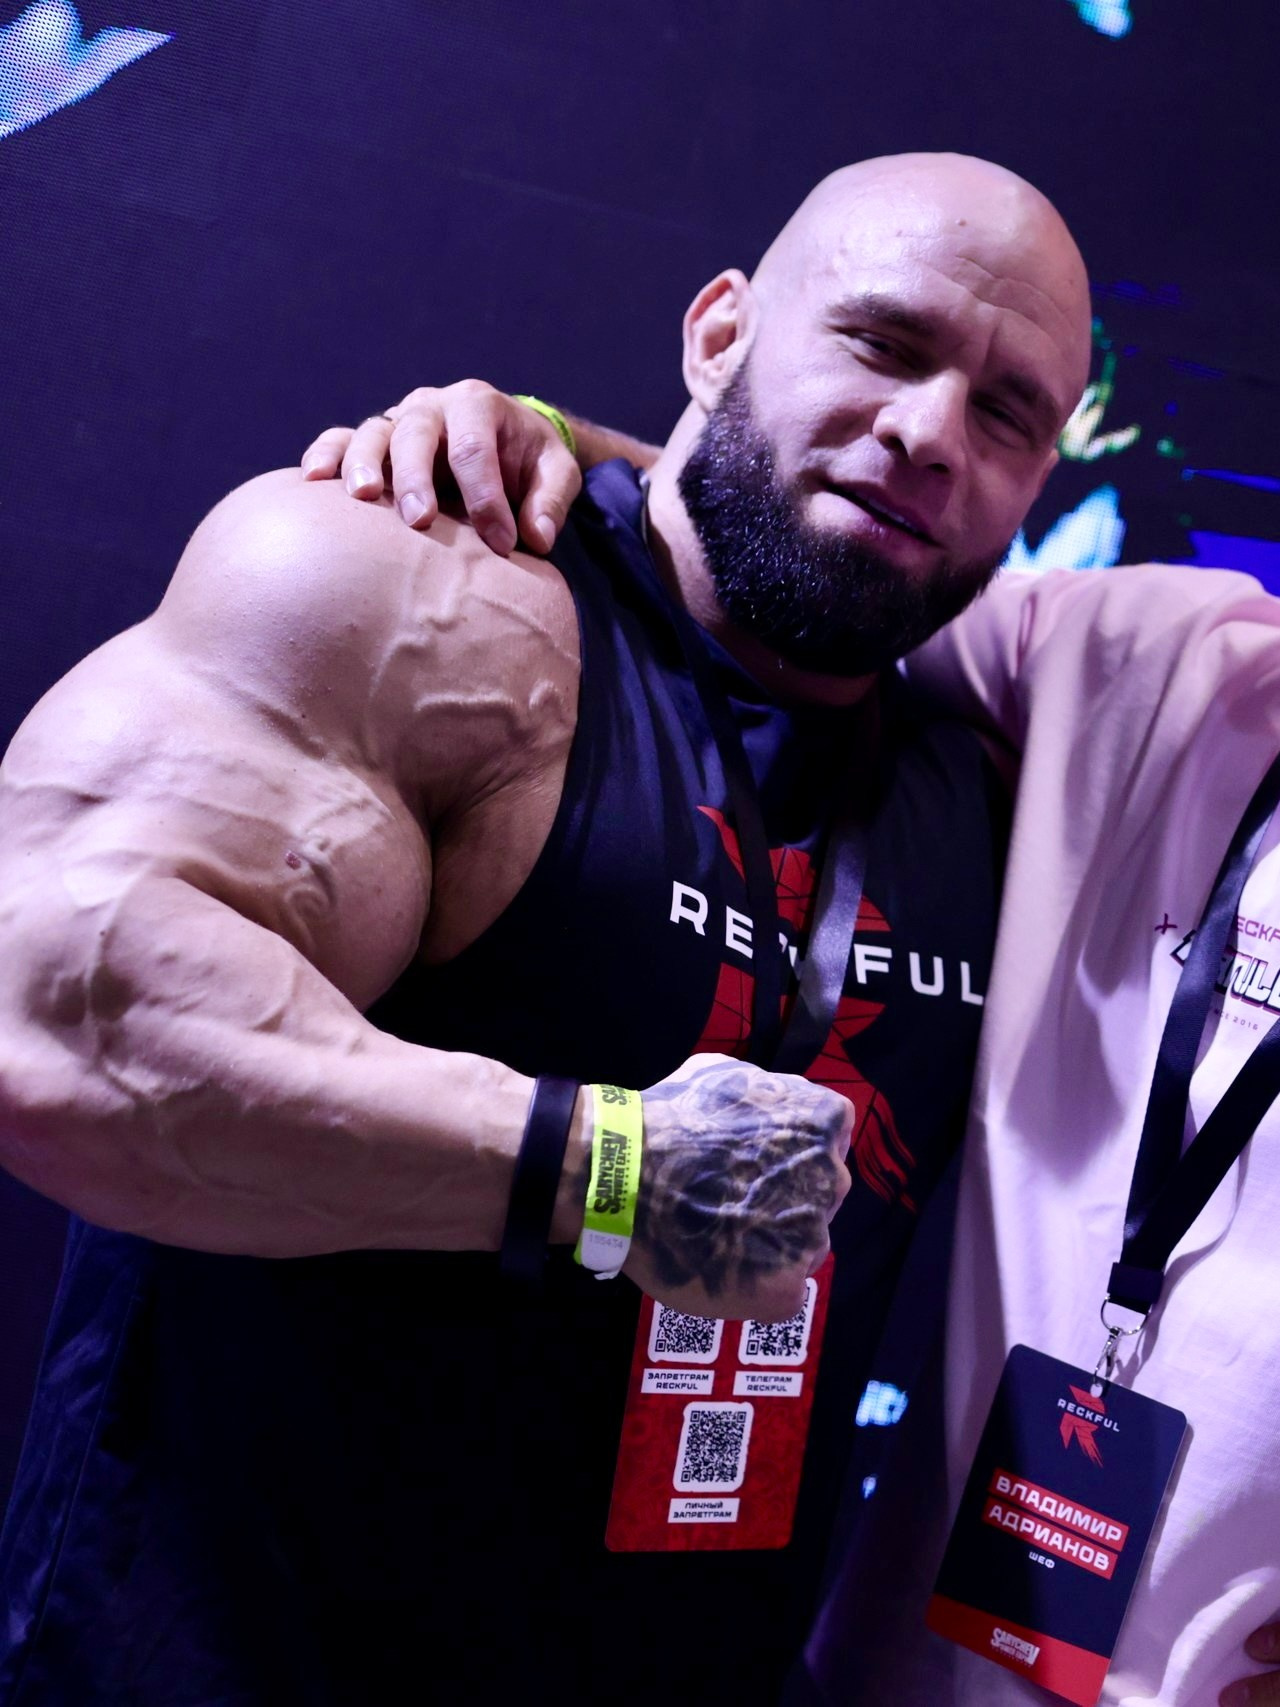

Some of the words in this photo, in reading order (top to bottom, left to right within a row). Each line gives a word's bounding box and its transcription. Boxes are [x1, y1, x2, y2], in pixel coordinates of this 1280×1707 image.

[669, 880, 985, 1006] REFUL
[593, 1129, 628, 1214] SARYCHEV
[648, 1372, 710, 1381] ЗАПРЕТГРАМ
[745, 1375, 793, 1384] ТЕЛЕГРАМ
[656, 1381, 698, 1390] RECKFUL
[746, 1383, 788, 1392] RECKFUL
[1057, 1398, 1120, 1432] RECKFUL
[685, 1500, 723, 1510] ЛИЧНЫЙ
[996, 1475, 1122, 1541] ВЛАДИМИР
[673, 1511, 732, 1519] ЗАПРЕТГРАМ
[989, 1505, 1110, 1571] АДРИАНОВ
[1028, 1551, 1055, 1569] ШЕФ
